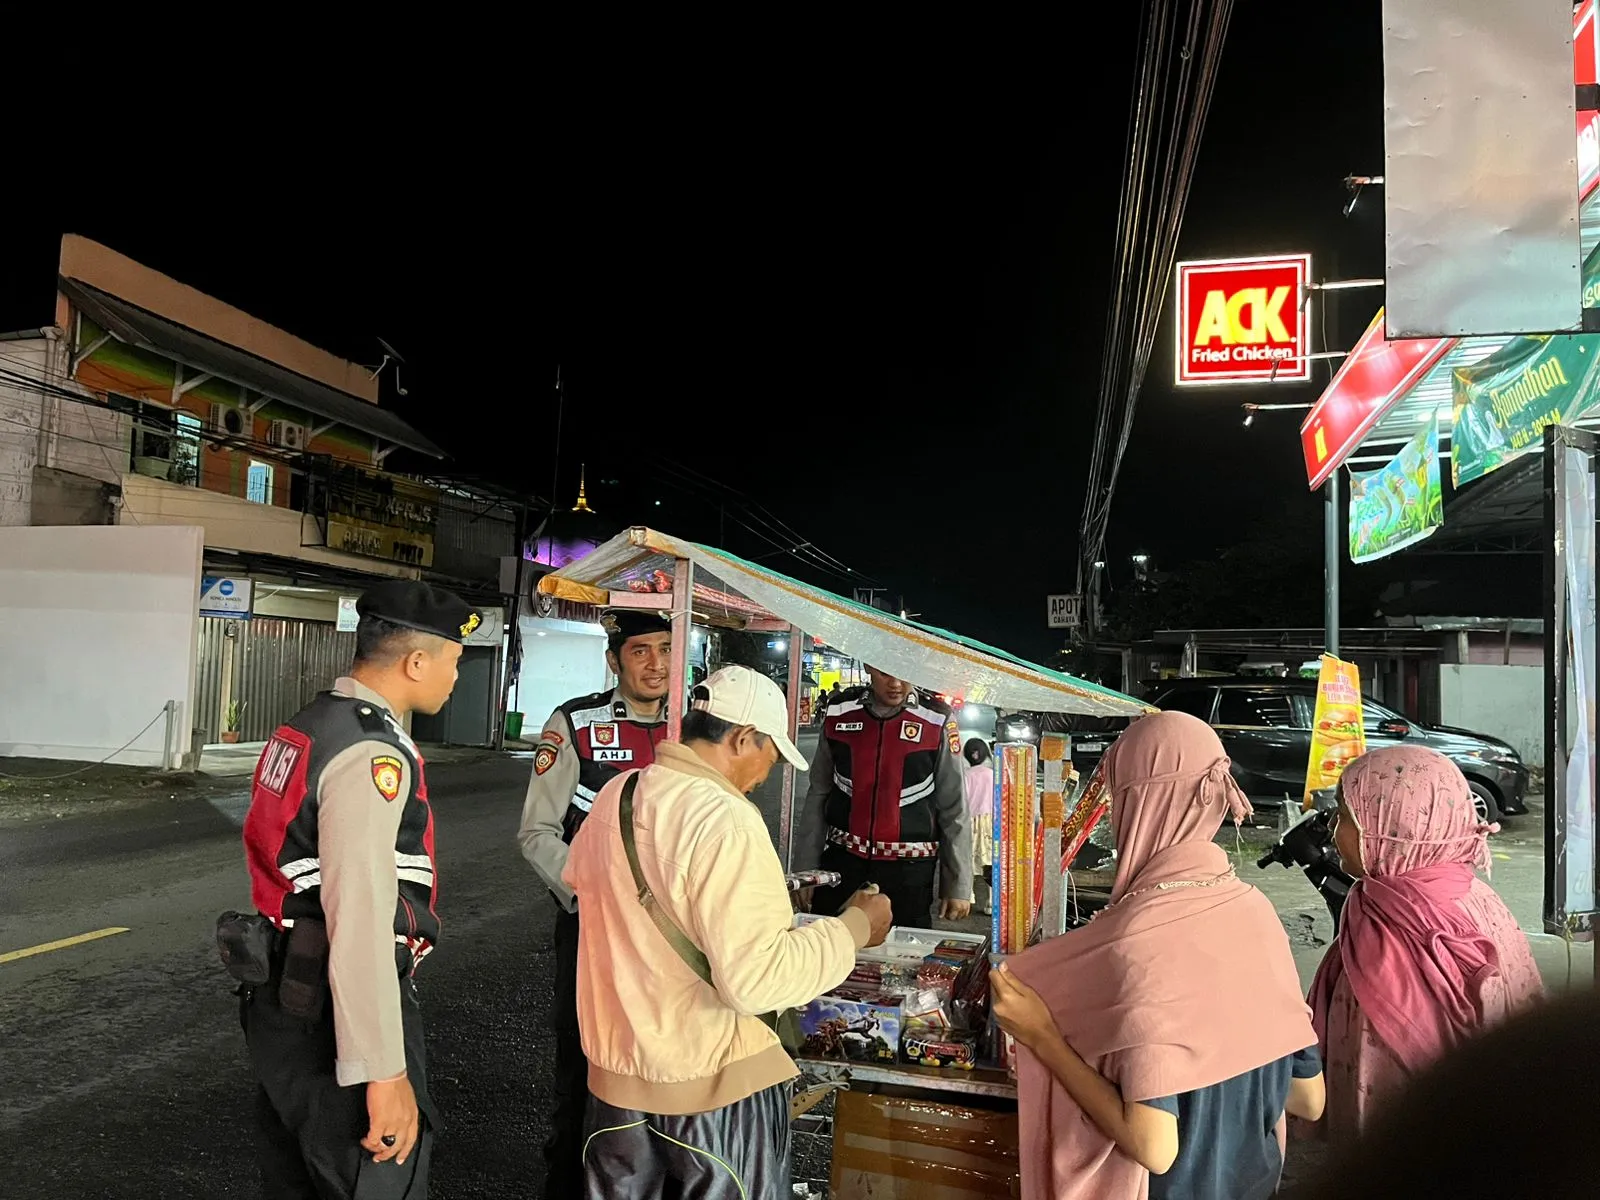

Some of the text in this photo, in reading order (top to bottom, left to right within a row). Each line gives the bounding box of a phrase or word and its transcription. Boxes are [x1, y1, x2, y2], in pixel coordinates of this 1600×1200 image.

[1191, 345, 1293, 362] Fried Chicken
[1490, 357, 1569, 428] Ramadhan
[1051, 598, 1080, 615] APOT
[600, 751, 627, 760] AHJ
[260, 738, 297, 793] OLISI
